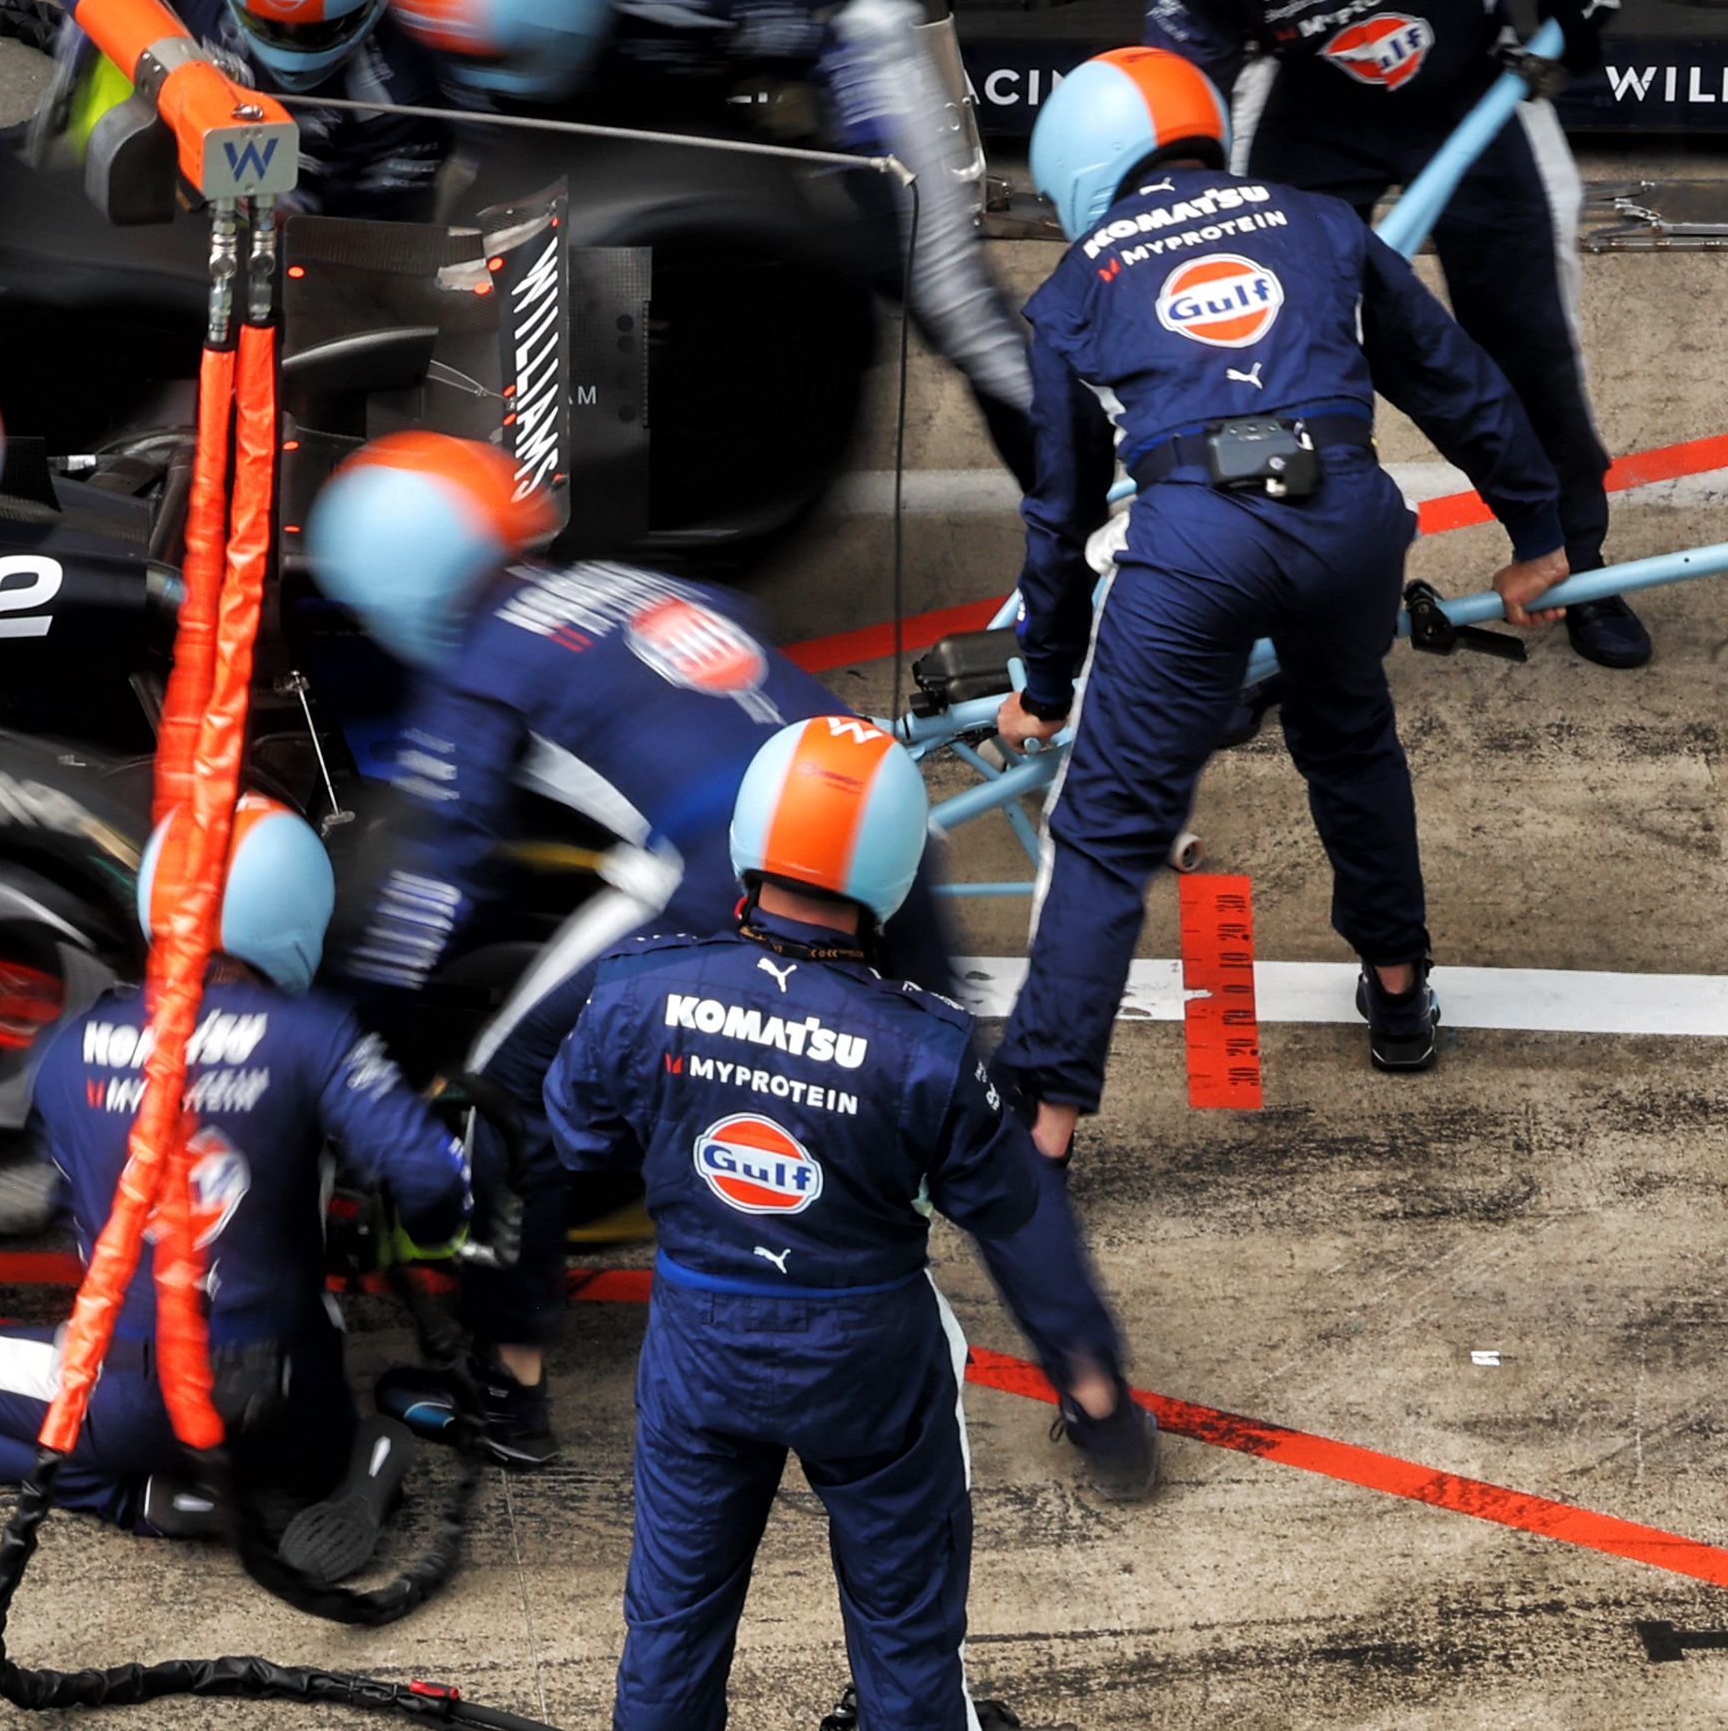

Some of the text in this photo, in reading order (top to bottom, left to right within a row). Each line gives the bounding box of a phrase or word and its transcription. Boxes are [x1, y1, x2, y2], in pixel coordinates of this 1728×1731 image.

[224, 137, 279, 182] W
[1082, 185, 1271, 260] KOMATSU
[1120, 210, 1288, 266] MYPROTEIN
[1168, 278, 1271, 321] Gulf
[510, 235, 559, 504] WILLIAMS
[665, 993, 868, 1069] KOMATSU
[690, 1055, 858, 1115] MYPROTEIN
[703, 1144, 812, 1192] Gulf
